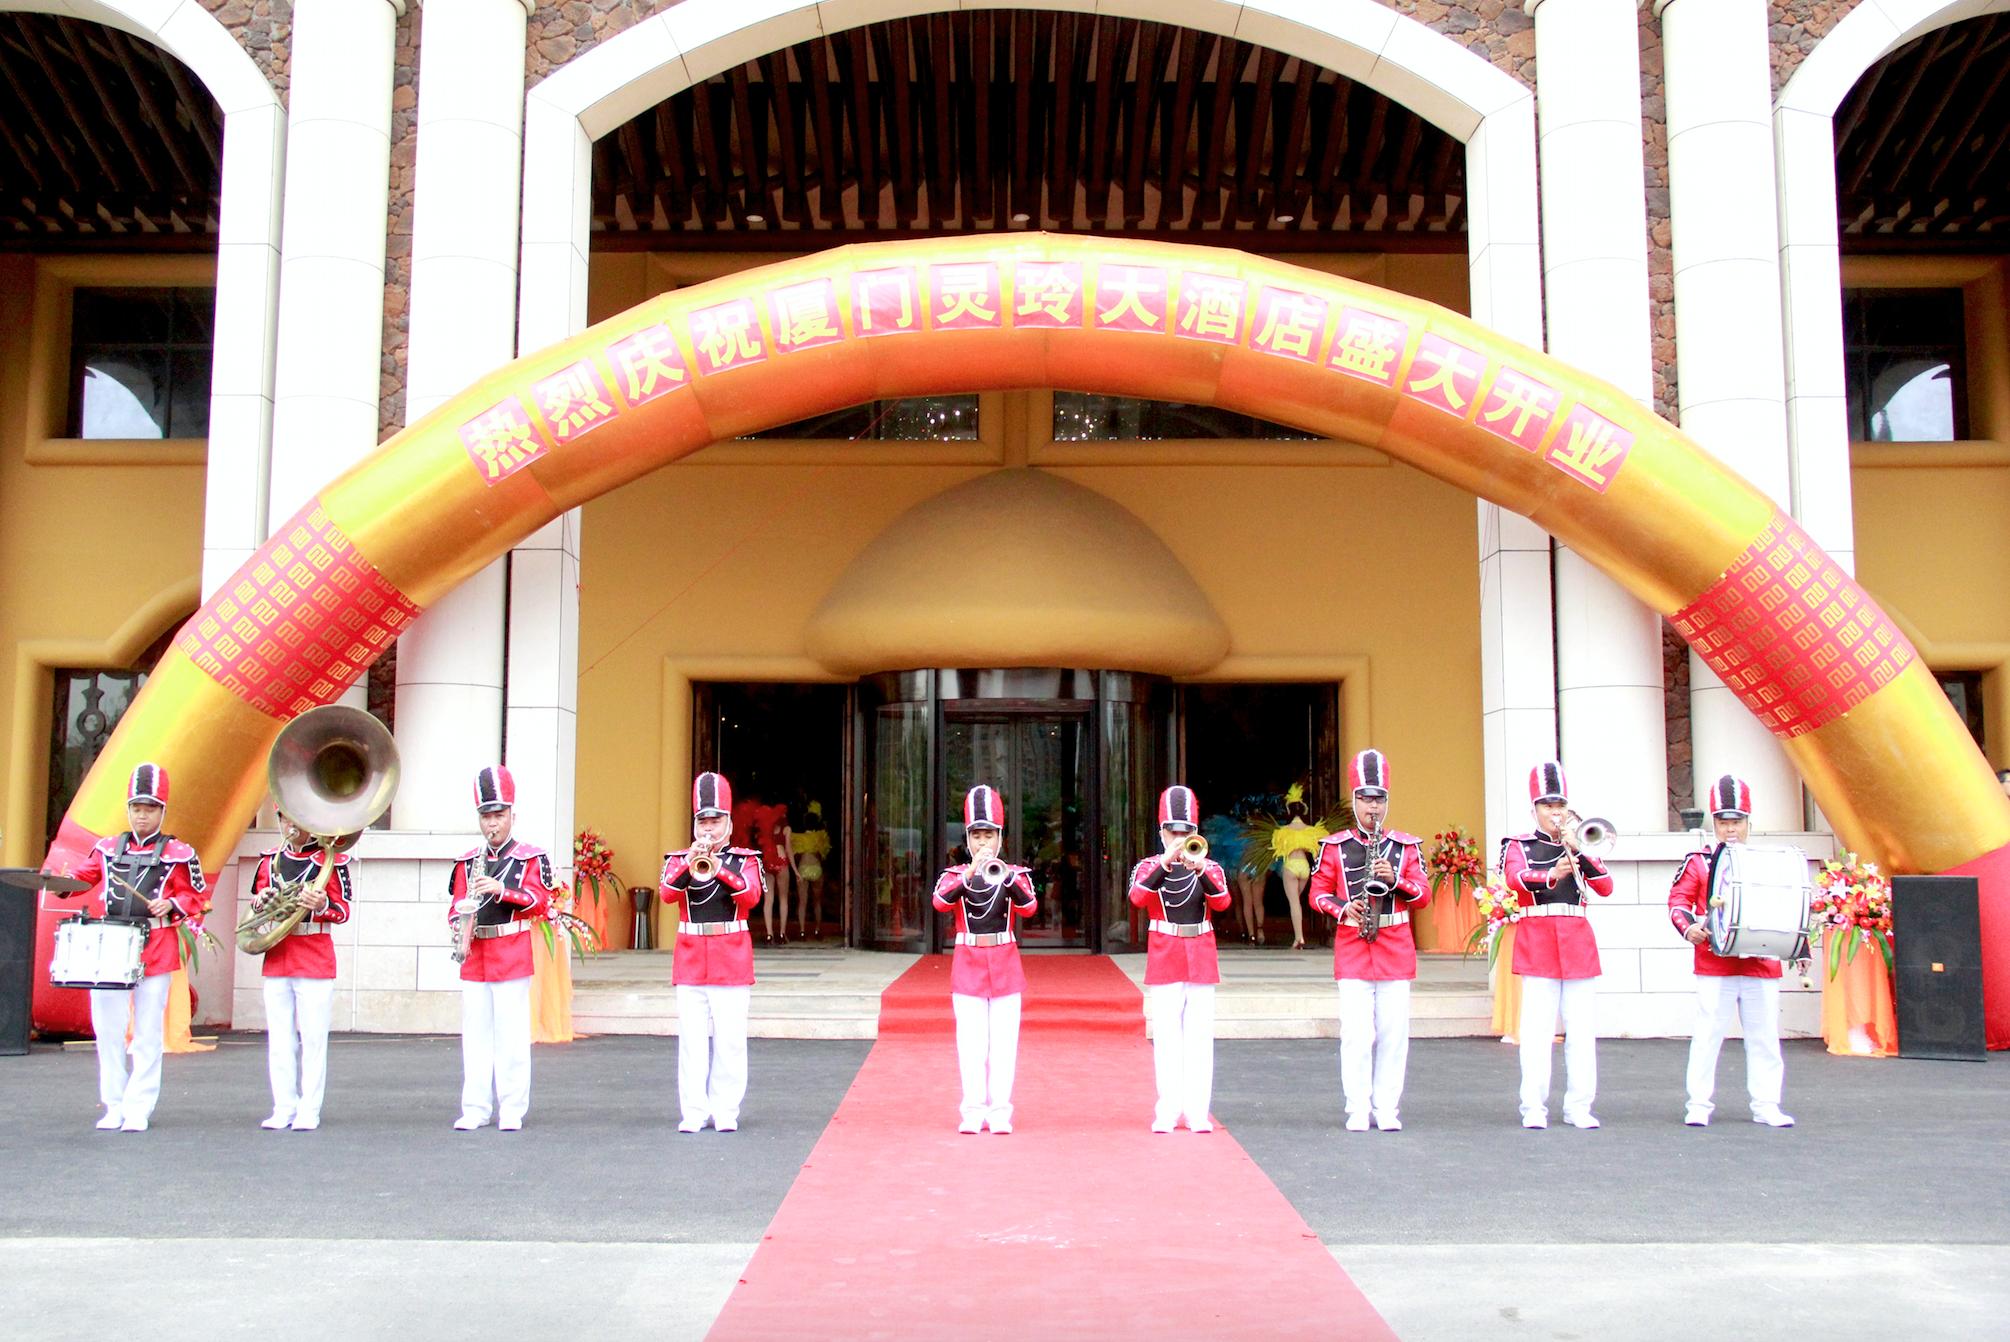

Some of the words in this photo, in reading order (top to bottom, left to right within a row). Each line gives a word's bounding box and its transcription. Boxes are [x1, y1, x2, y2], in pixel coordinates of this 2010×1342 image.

[467, 264, 1623, 485] 热烈庆祝厦门灵玲大酒店盛大开业
